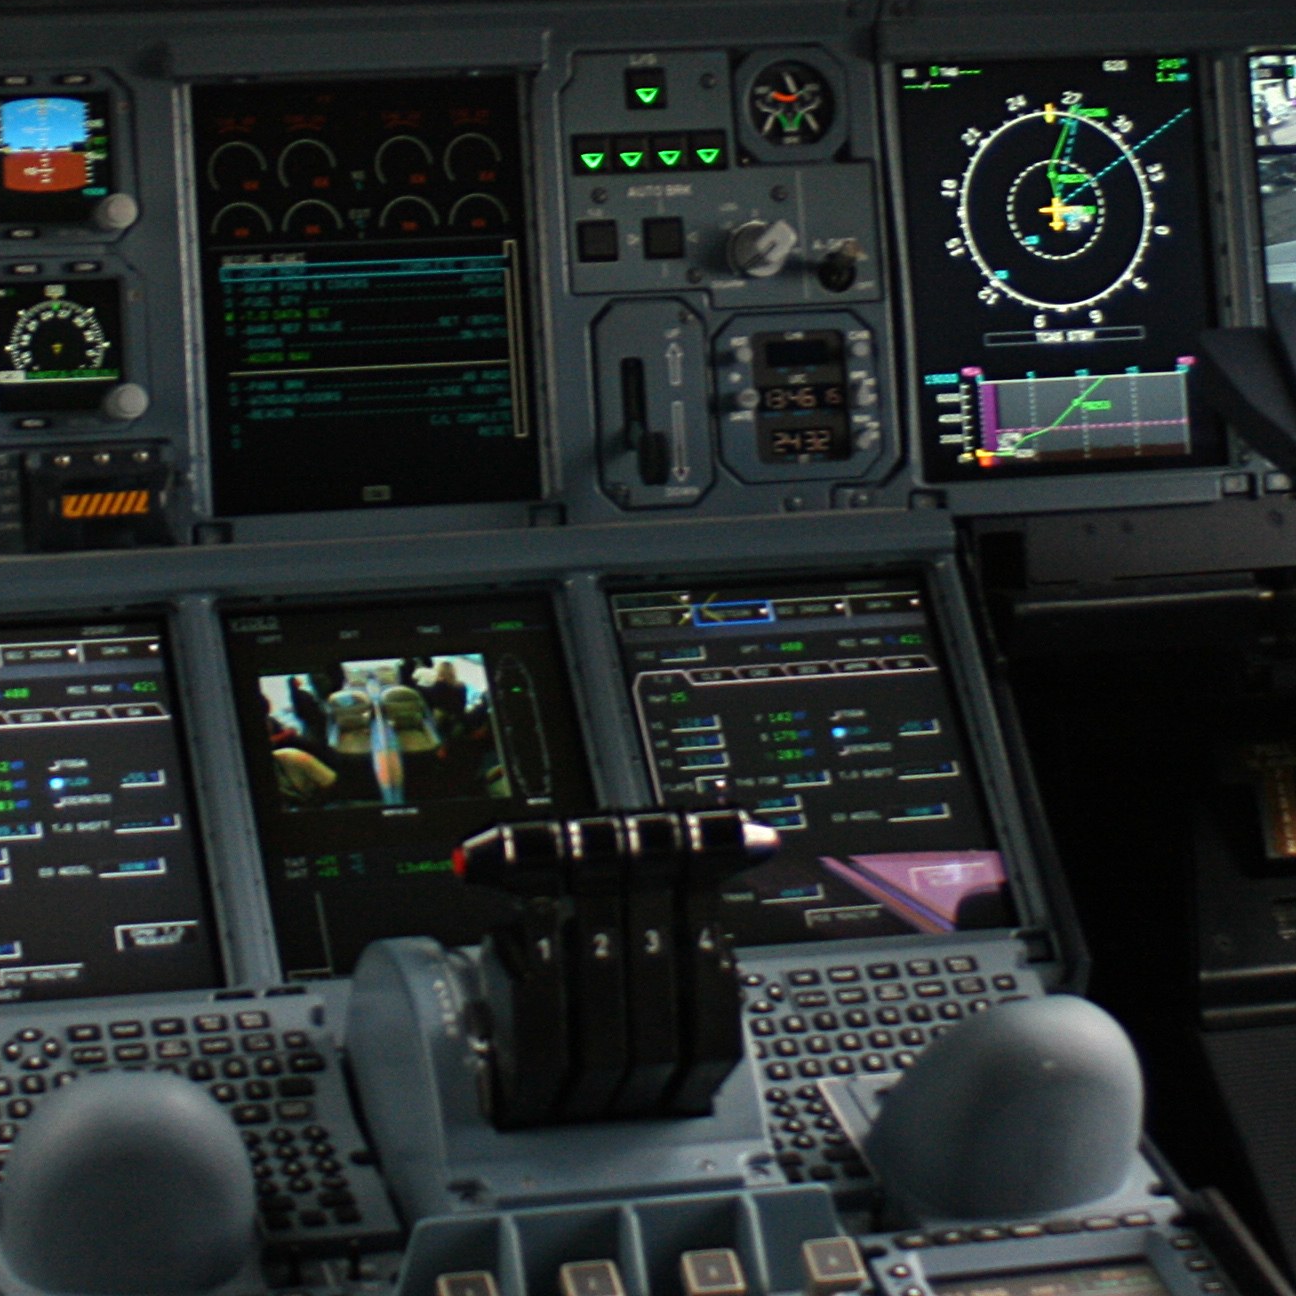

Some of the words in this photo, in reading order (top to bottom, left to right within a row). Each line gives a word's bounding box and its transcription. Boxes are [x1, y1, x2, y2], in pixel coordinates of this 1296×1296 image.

[537, 937, 552, 961] 1
[592, 933, 610, 959] 2
[644, 929, 662, 954] 3
[697, 926, 714, 950] 4
